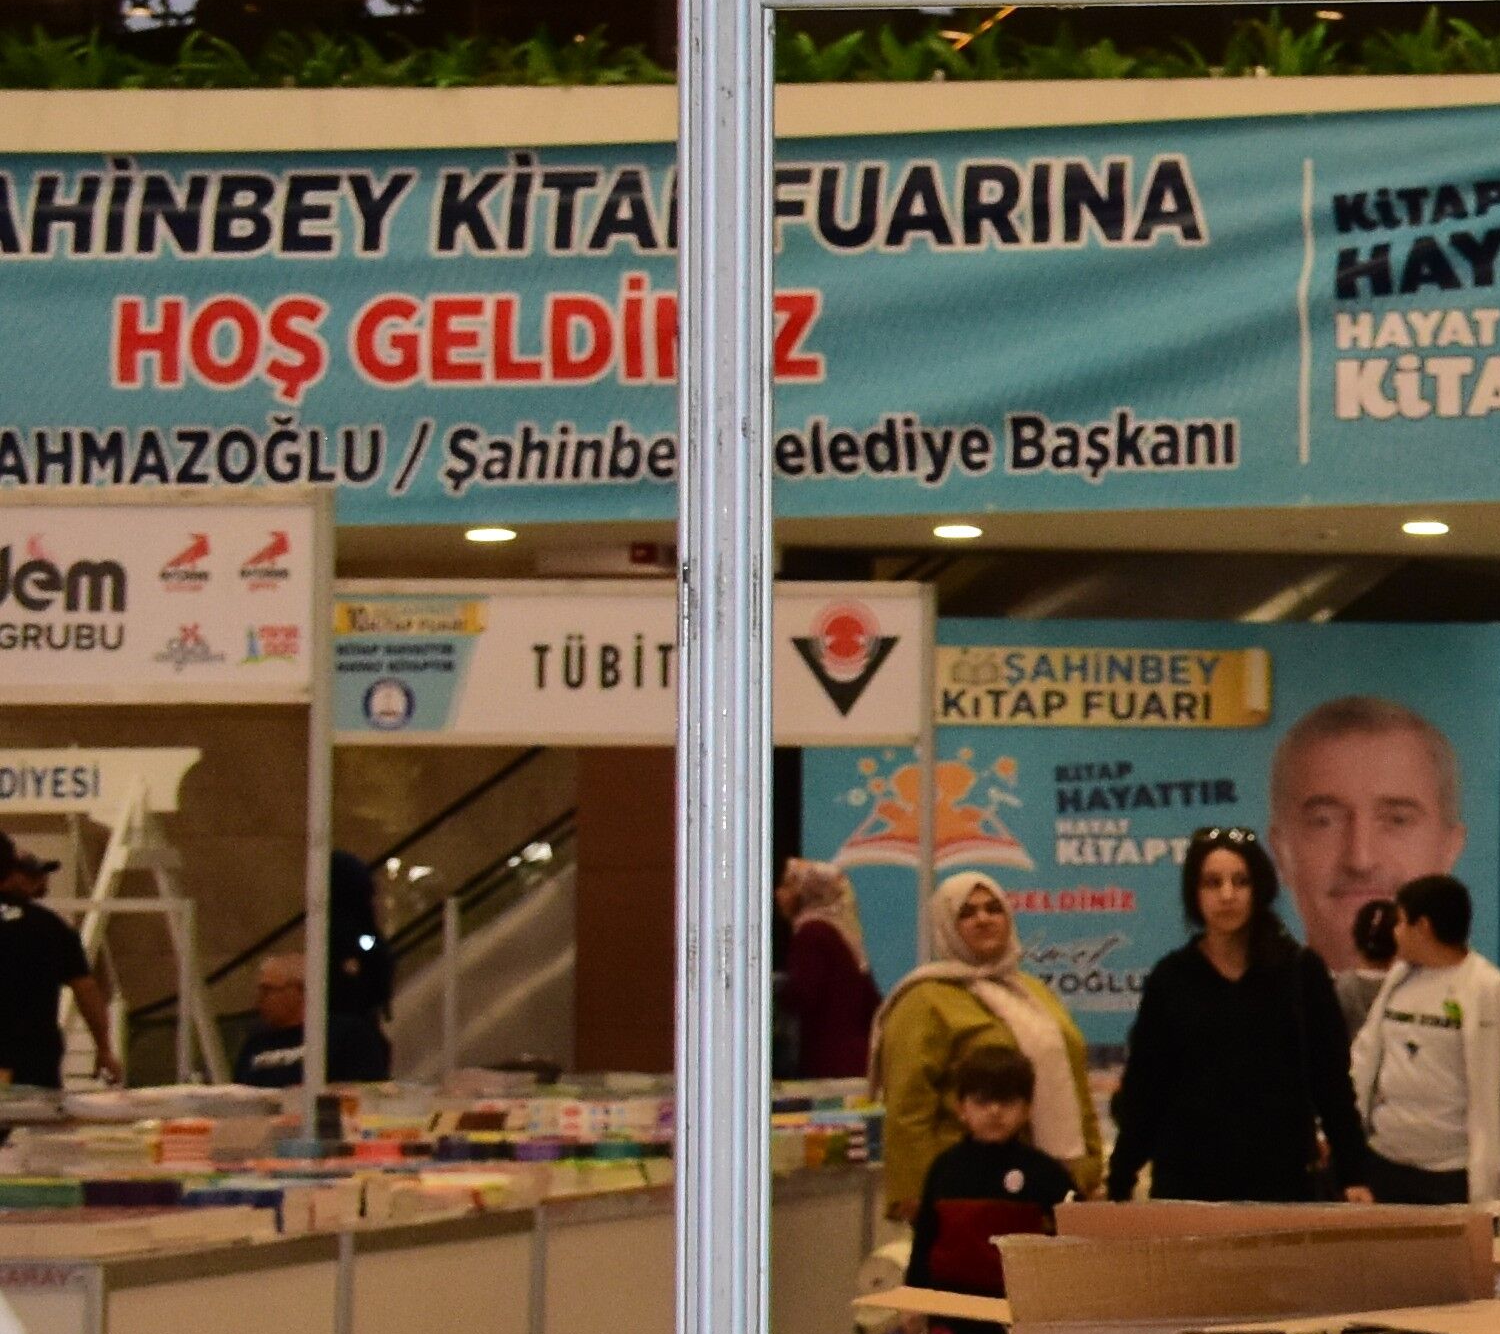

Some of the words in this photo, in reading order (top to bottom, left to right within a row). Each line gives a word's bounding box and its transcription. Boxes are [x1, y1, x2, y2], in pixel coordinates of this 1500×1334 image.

[0, 156, 418, 256] HİNBEY
[113, 294, 329, 402] HOŞ
[350, 273, 824, 383] GELDİZ
[0, 413, 383, 485] AHMAZOĞLU
[446, 424, 678, 496] Şahinbe
[774, 412, 993, 486] elediye
[1010, 410, 1238, 482] Başkanı
[532, 633, 675, 690] TÜBİT
[1083, 690, 1213, 721] FUARI
[1056, 778, 1239, 815] HAYATTIR
